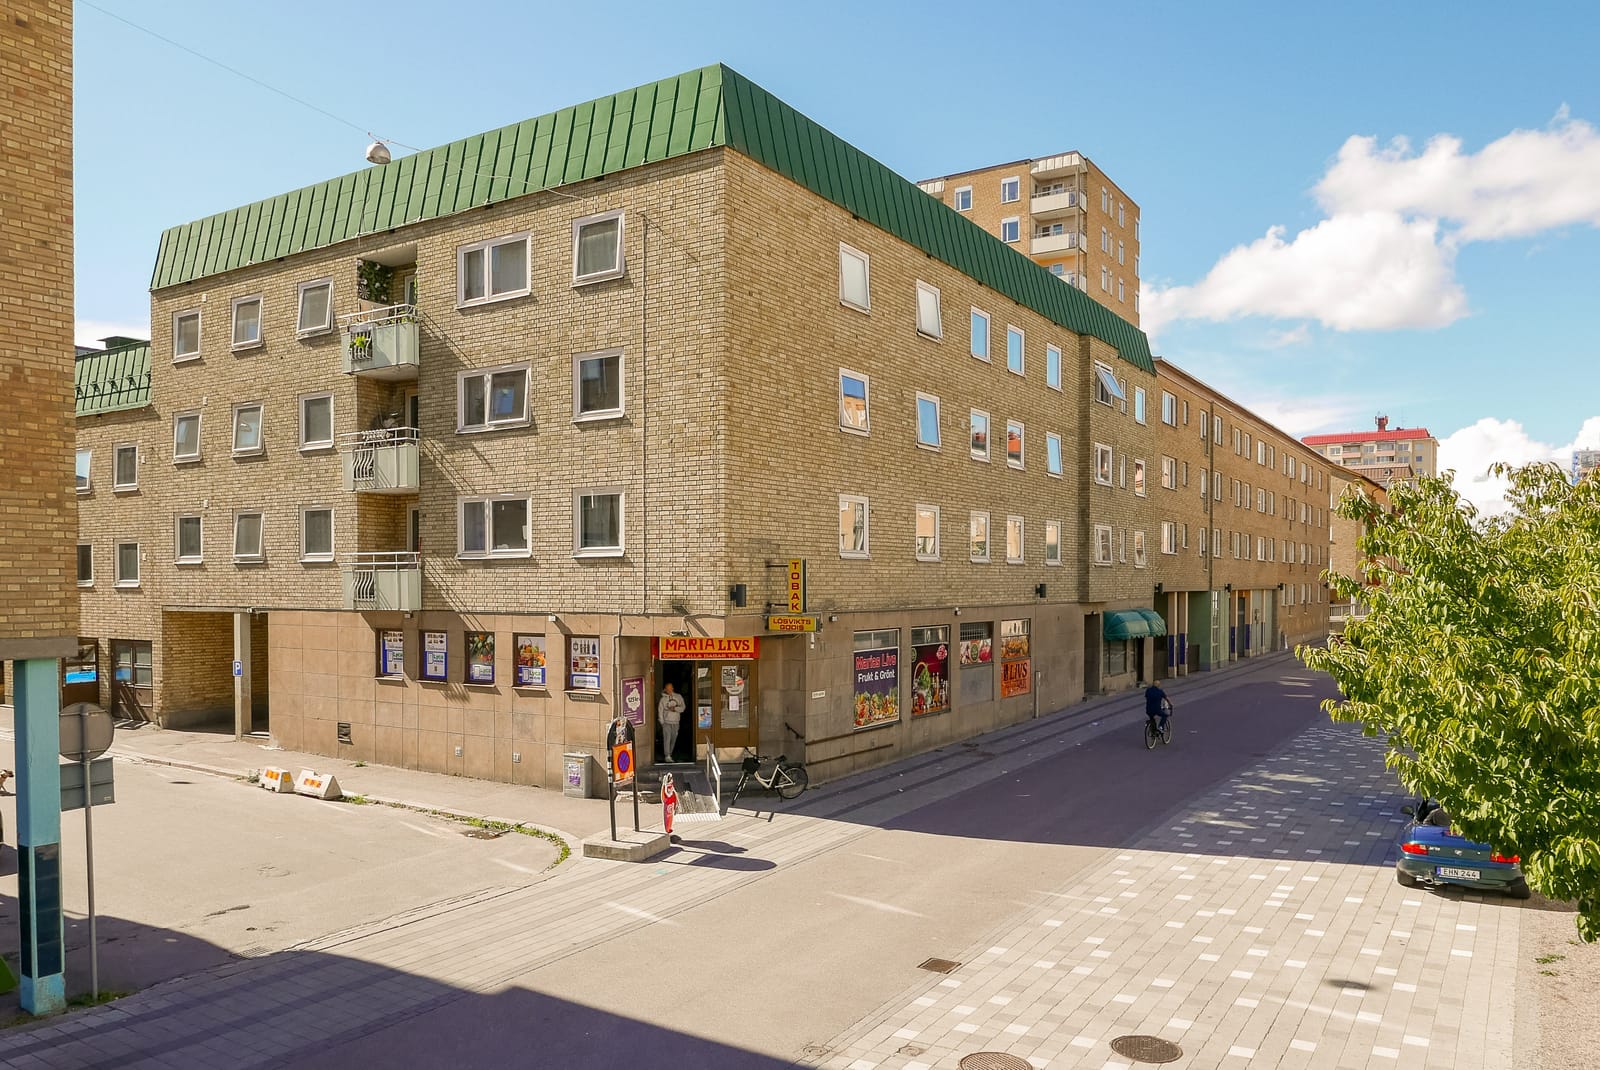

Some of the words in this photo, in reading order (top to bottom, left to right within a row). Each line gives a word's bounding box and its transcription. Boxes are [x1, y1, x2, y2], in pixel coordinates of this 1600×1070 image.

[791, 562, 800, 610] TOBAK
[665, 638, 715, 651] MARIA
[718, 640, 750, 651] LIVS
[235, 662, 241, 675] P
[858, 672, 874, 683] Frukt
[874, 671, 879, 680] &
[879, 669, 896, 680] Grönt
